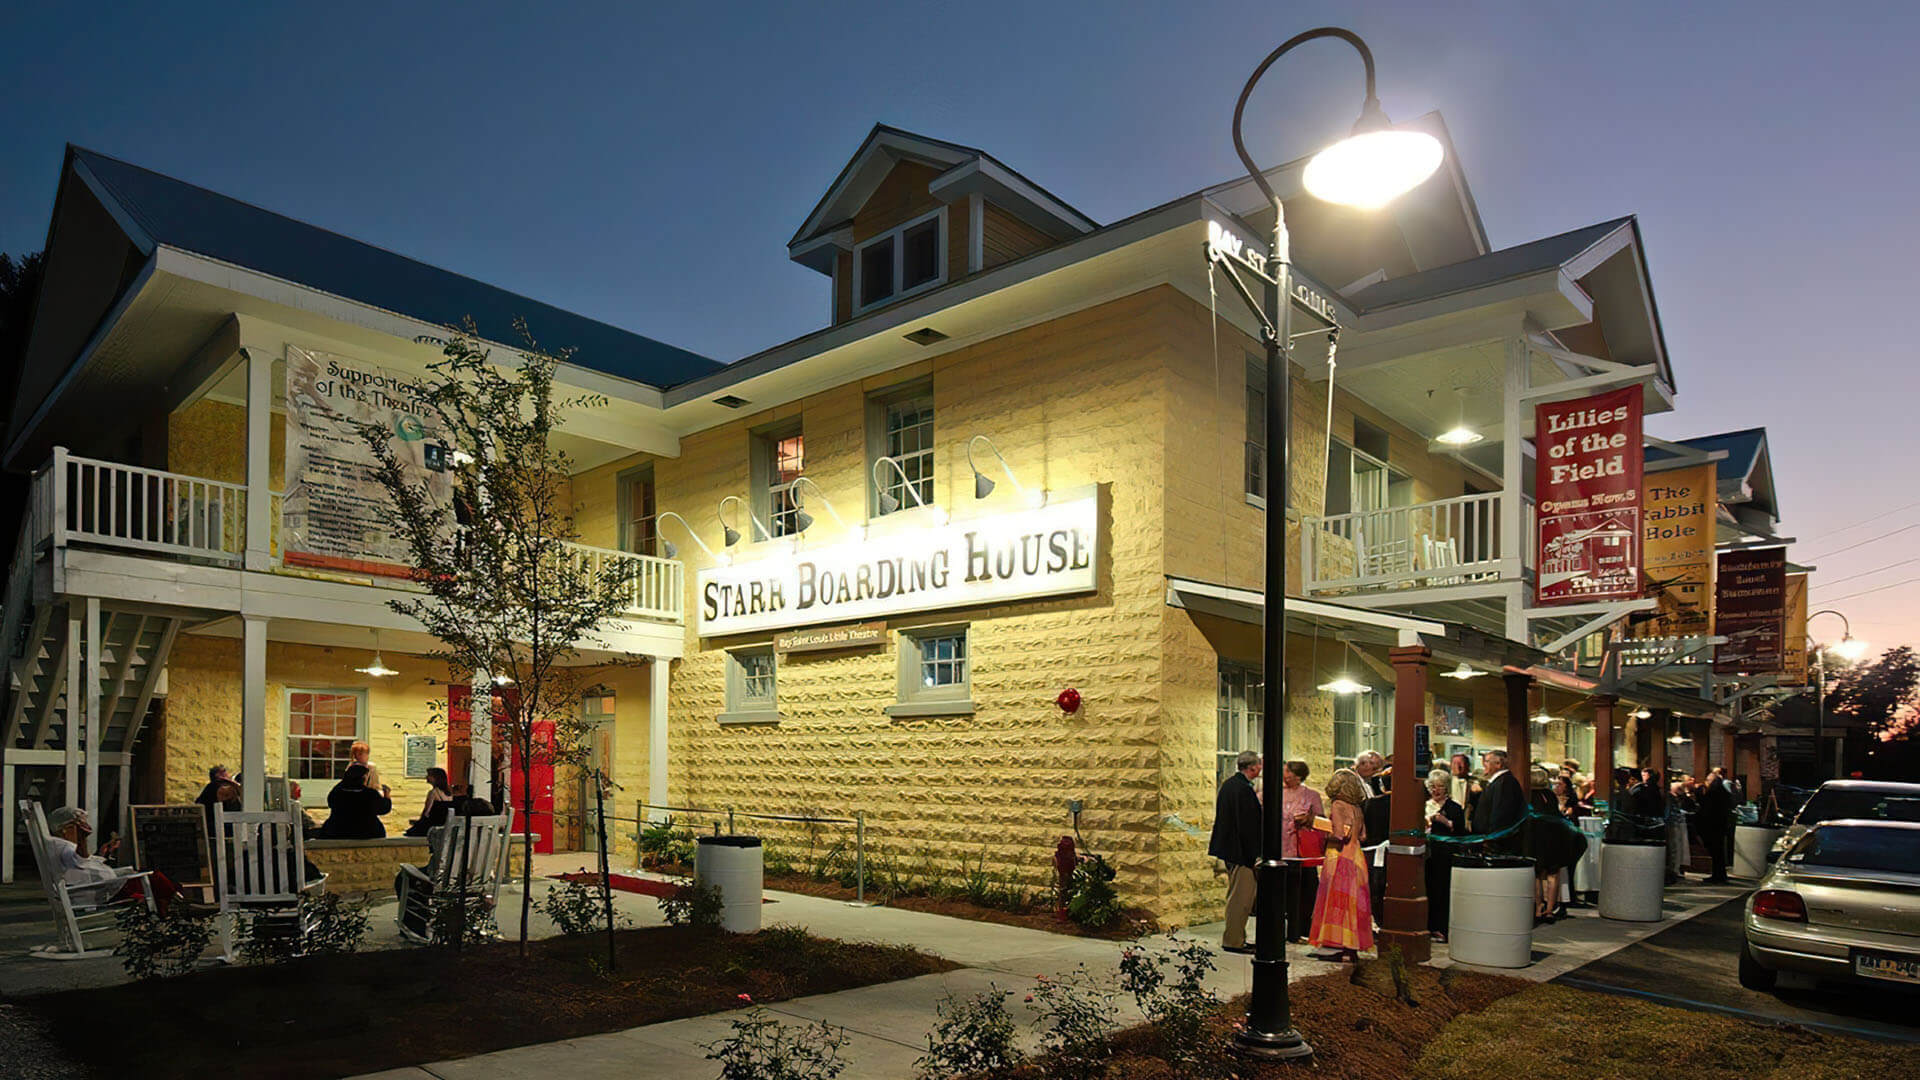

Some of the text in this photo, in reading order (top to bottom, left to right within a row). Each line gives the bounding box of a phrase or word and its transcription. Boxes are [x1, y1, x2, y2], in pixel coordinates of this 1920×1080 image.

[315, 381, 335, 398] of
[340, 384, 367, 402] the
[1548, 405, 1628, 434] Lilies
[1549, 433, 1627, 459] of the
[1550, 455, 1624, 485] Field
[1649, 486, 1691, 501] The
[1647, 524, 1697, 541] Hole
[703, 529, 1090, 621] STARR BOARDING HOUSE
